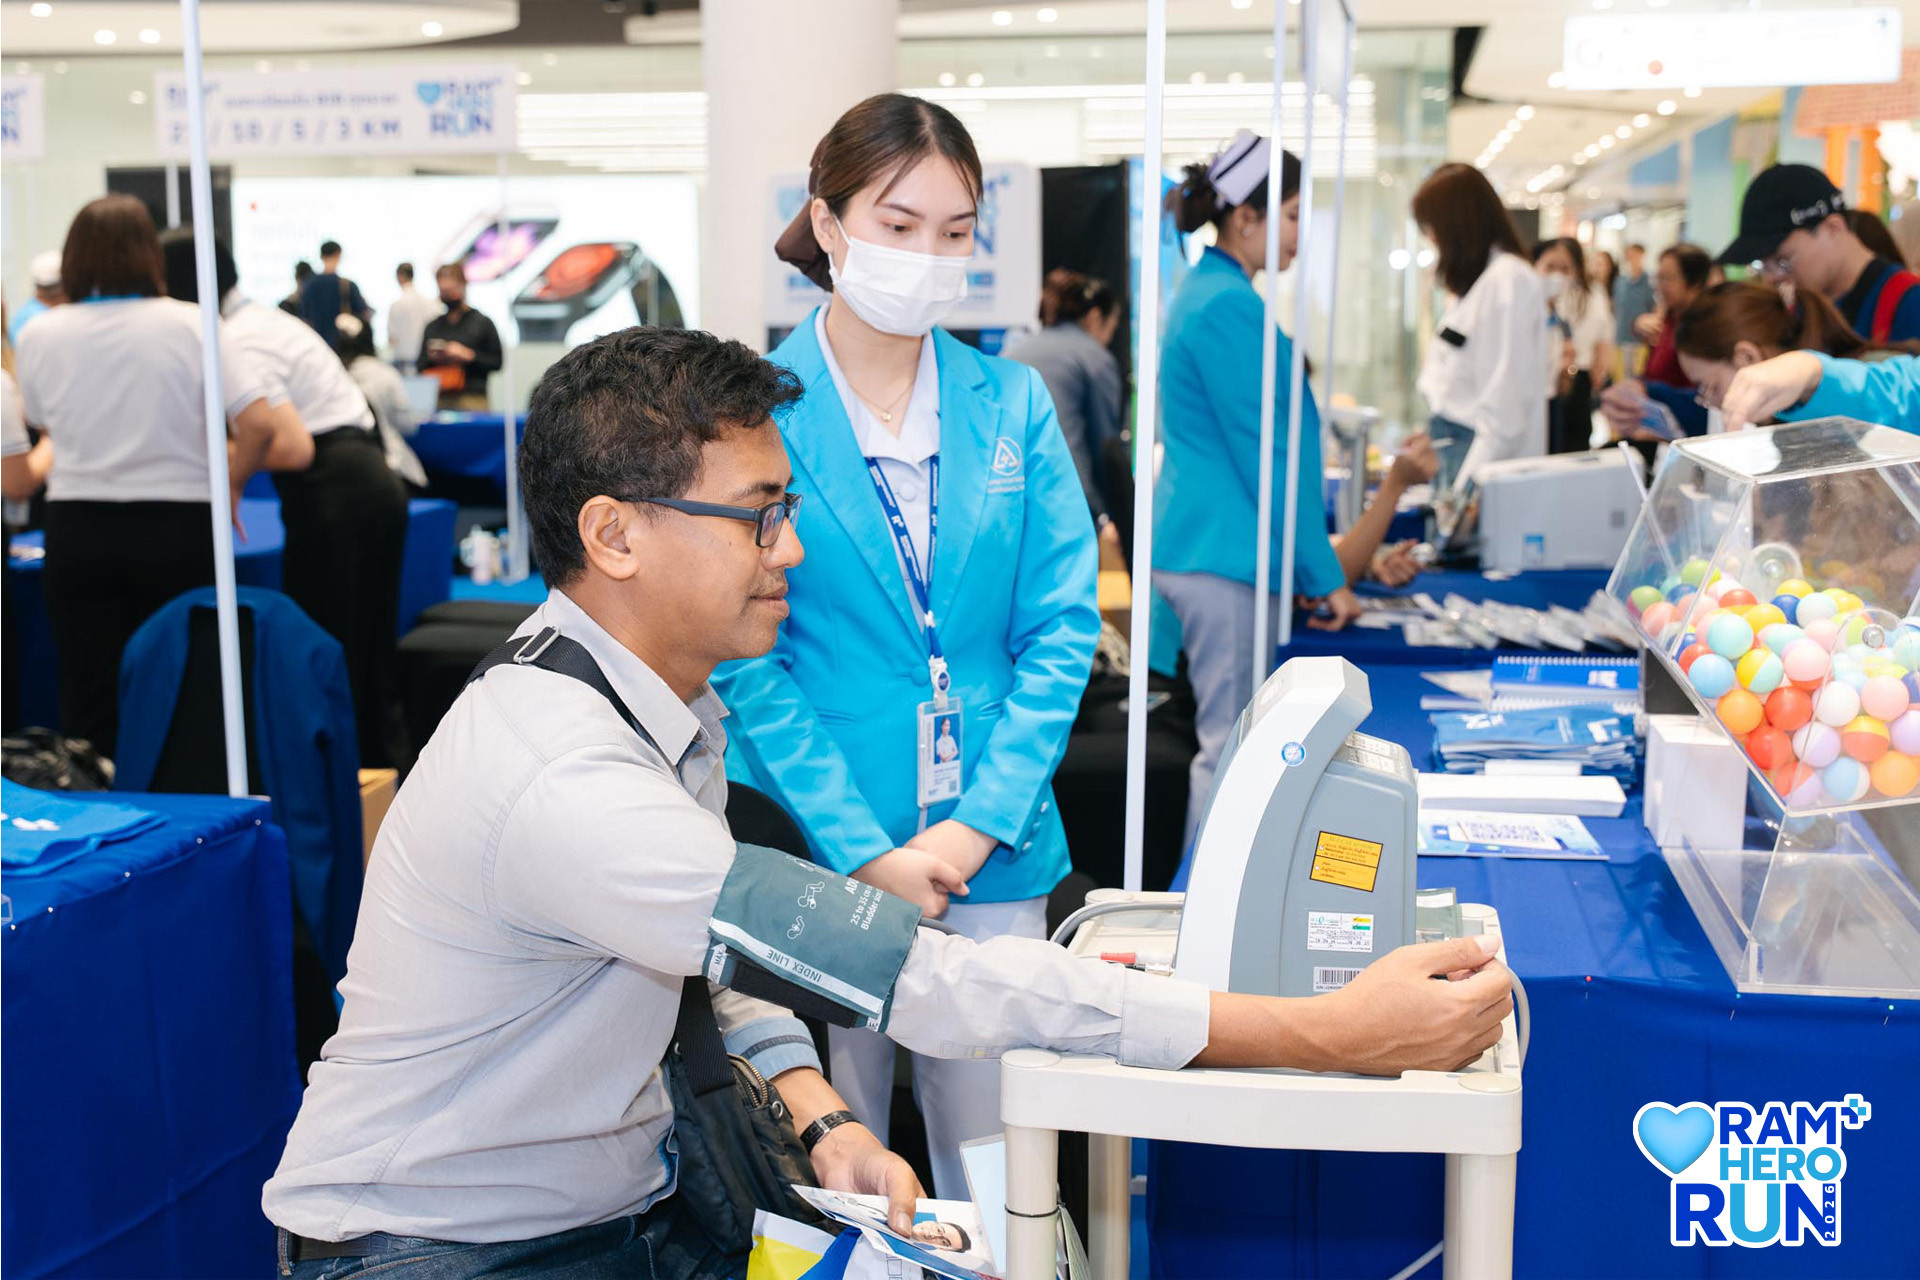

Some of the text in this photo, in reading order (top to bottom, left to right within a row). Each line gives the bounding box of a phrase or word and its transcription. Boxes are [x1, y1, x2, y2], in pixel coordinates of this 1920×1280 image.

[429, 112, 493, 136] RUN
[856, 905, 864, 914] to
[859, 896, 868, 906] 35
[850, 913, 860, 926] 25
[860, 901, 878, 931] Bladder
[766, 949, 822, 983] INDEX LINE
